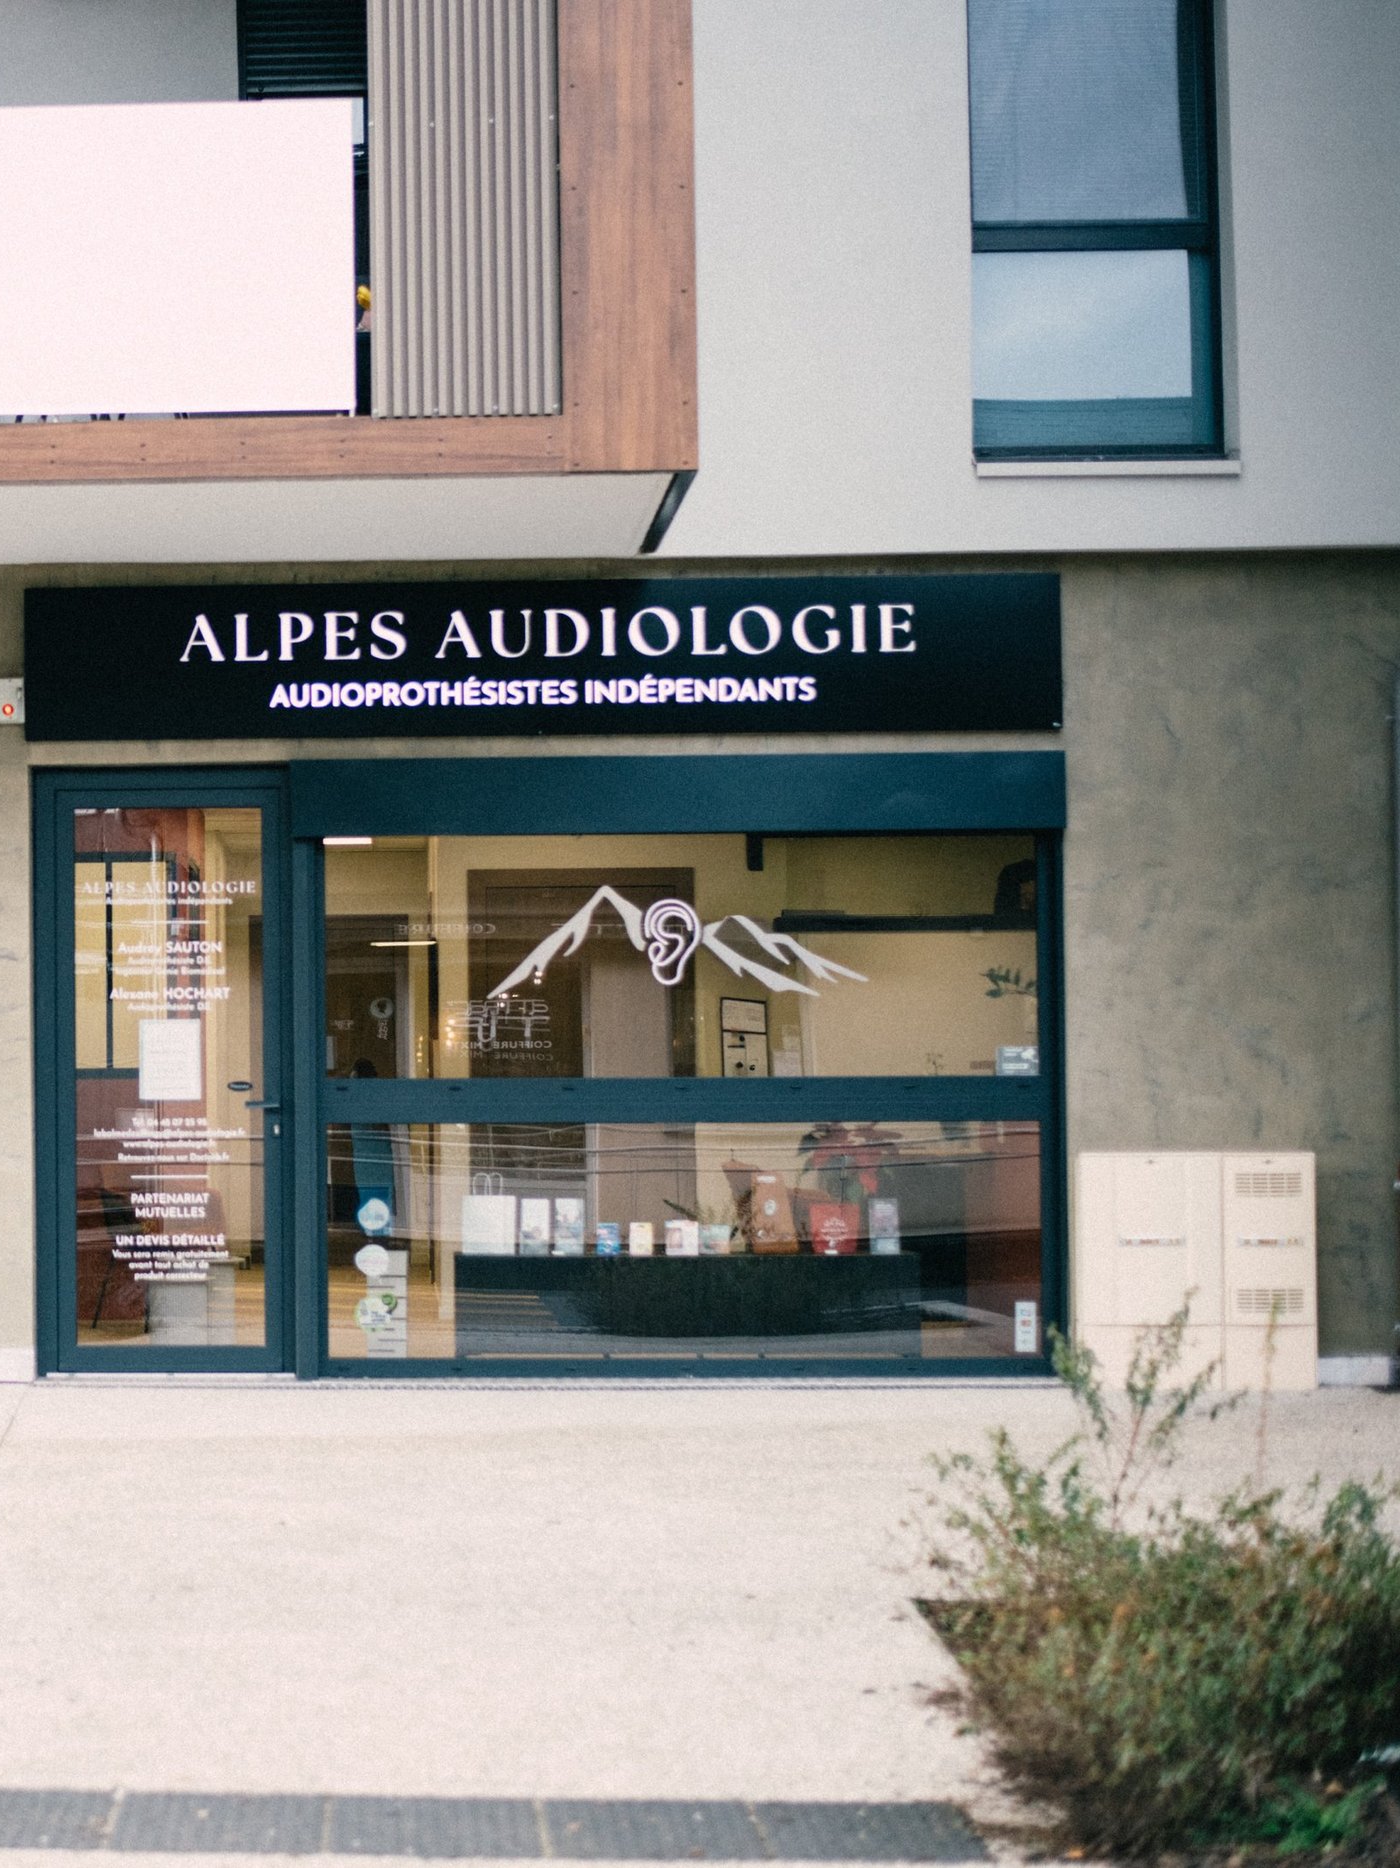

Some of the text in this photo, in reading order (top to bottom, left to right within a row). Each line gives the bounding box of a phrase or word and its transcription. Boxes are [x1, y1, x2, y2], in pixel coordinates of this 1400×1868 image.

[180, 603, 917, 663] ALPES AUDIOLOGIE
[269, 673, 817, 710] AUDIOPROTHÉSISTES INDÉPENDANTS
[82, 881, 256, 894] ALPES AUDIOLOGIE
[166, 941, 222, 953] SAUTON
[163, 987, 231, 999] HOCHART
[130, 1192, 209, 1205] PARTENARIAT
[135, 1206, 205, 1218] MUTUELLES
[115, 1233, 225, 1246] UN DEVIS DÉTAILLÉ
[112, 1249, 132, 1258] Vous
